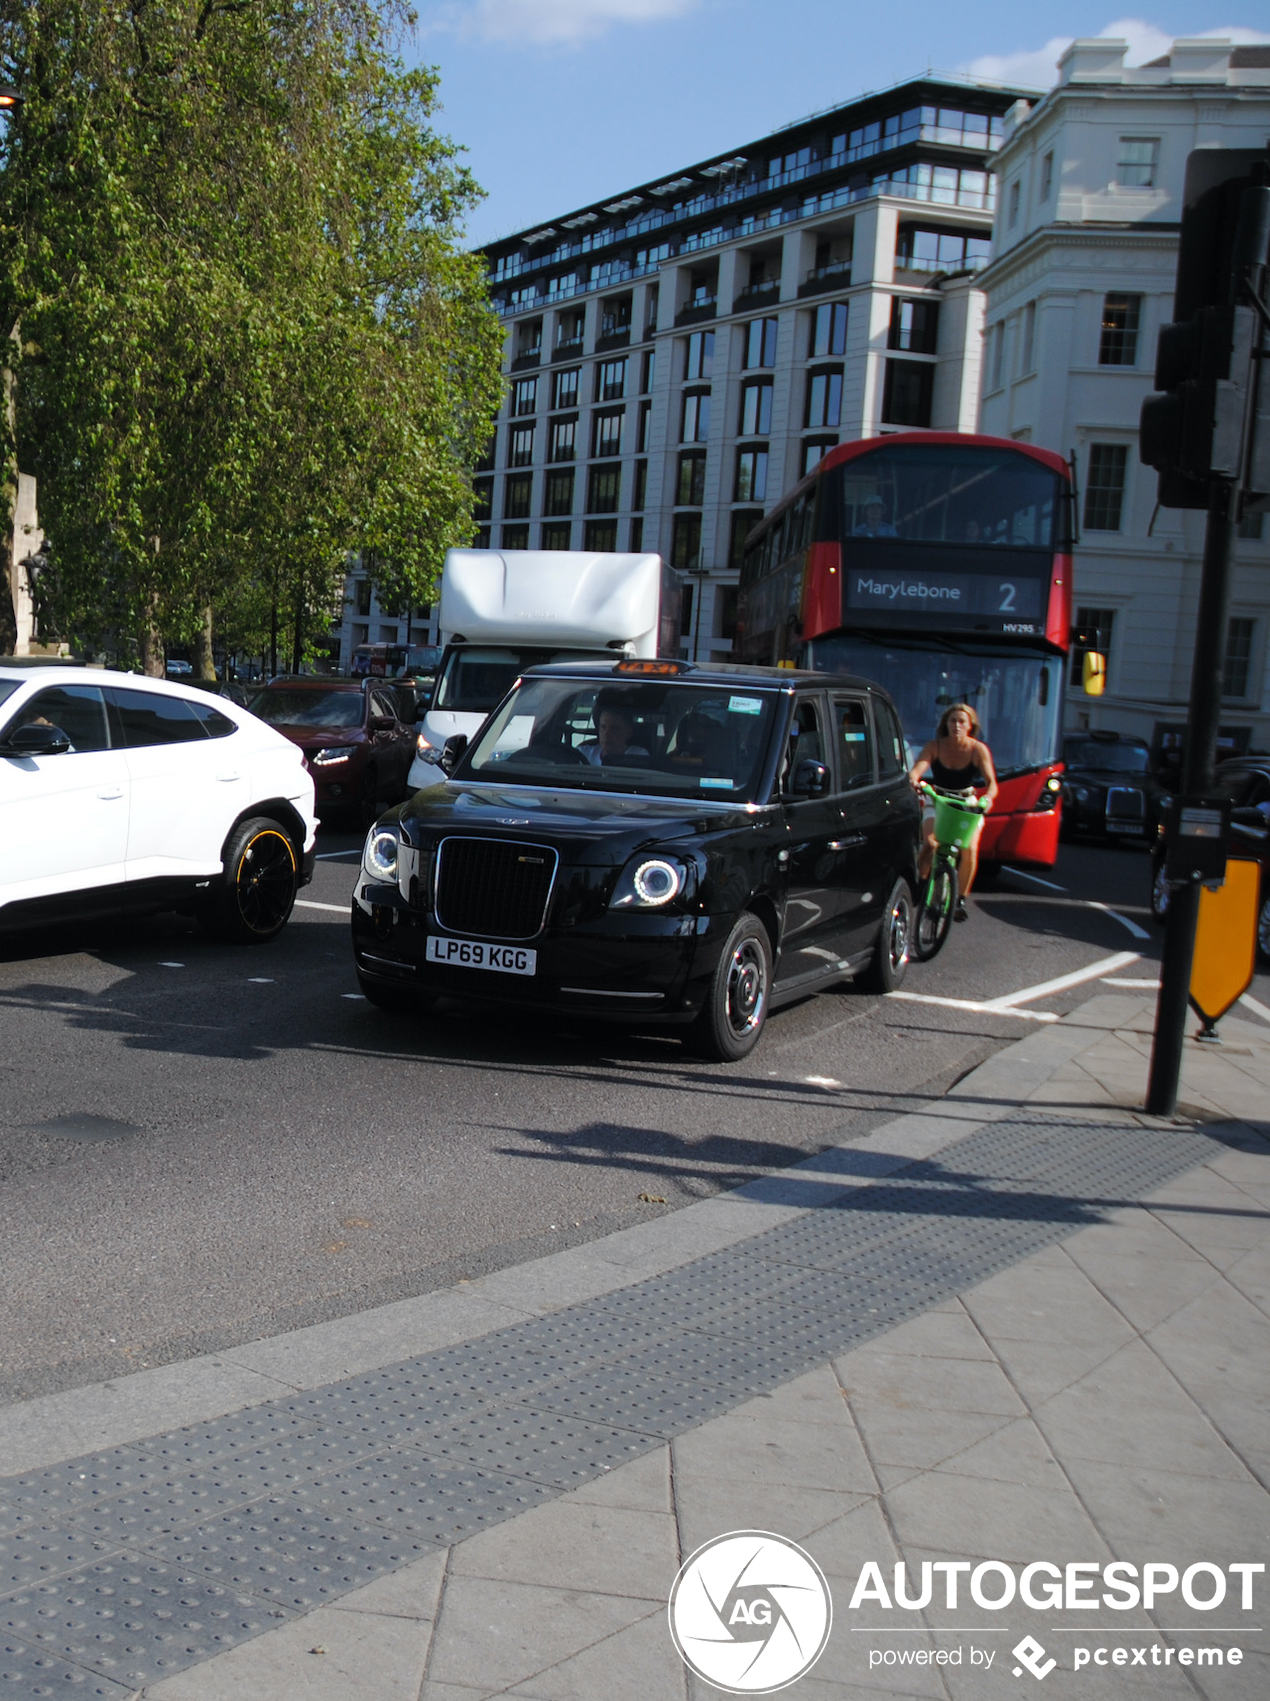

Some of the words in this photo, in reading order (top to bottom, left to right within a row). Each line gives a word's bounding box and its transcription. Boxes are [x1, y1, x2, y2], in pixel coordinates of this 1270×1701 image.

[857, 578, 961, 600] Marylebone
[998, 582, 1017, 612] 2
[434, 939, 484, 965] LP69
[489, 946, 528, 970] KGG
